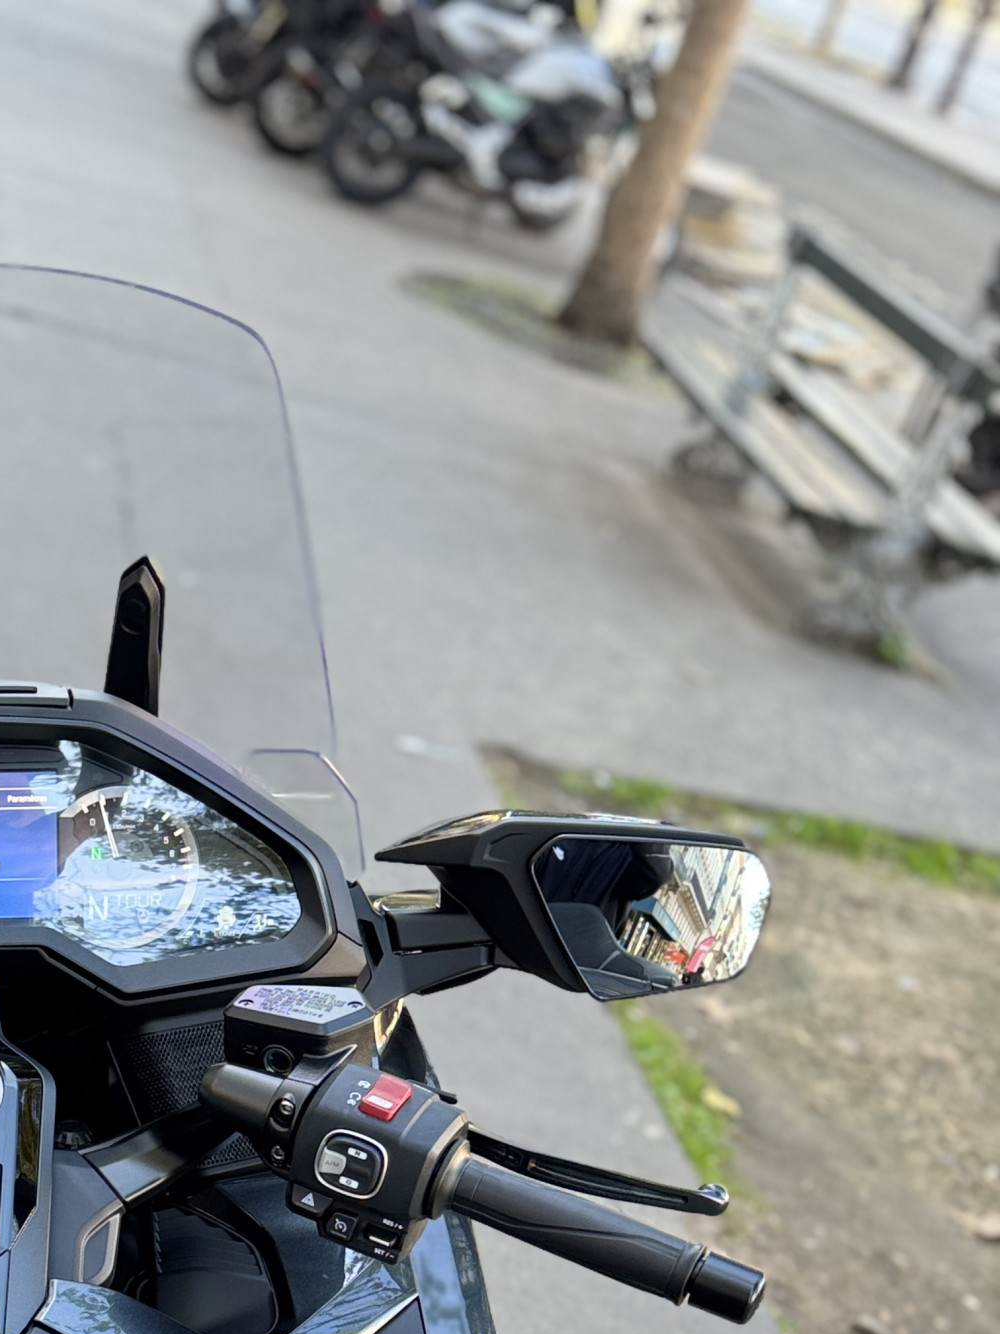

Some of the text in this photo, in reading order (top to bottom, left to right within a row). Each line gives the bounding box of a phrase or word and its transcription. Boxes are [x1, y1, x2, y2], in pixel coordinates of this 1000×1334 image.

[153, 823, 159, 832] 4
[91, 847, 103, 860] N
[115, 893, 162, 908] TOUR
[88, 895, 109, 921] N
